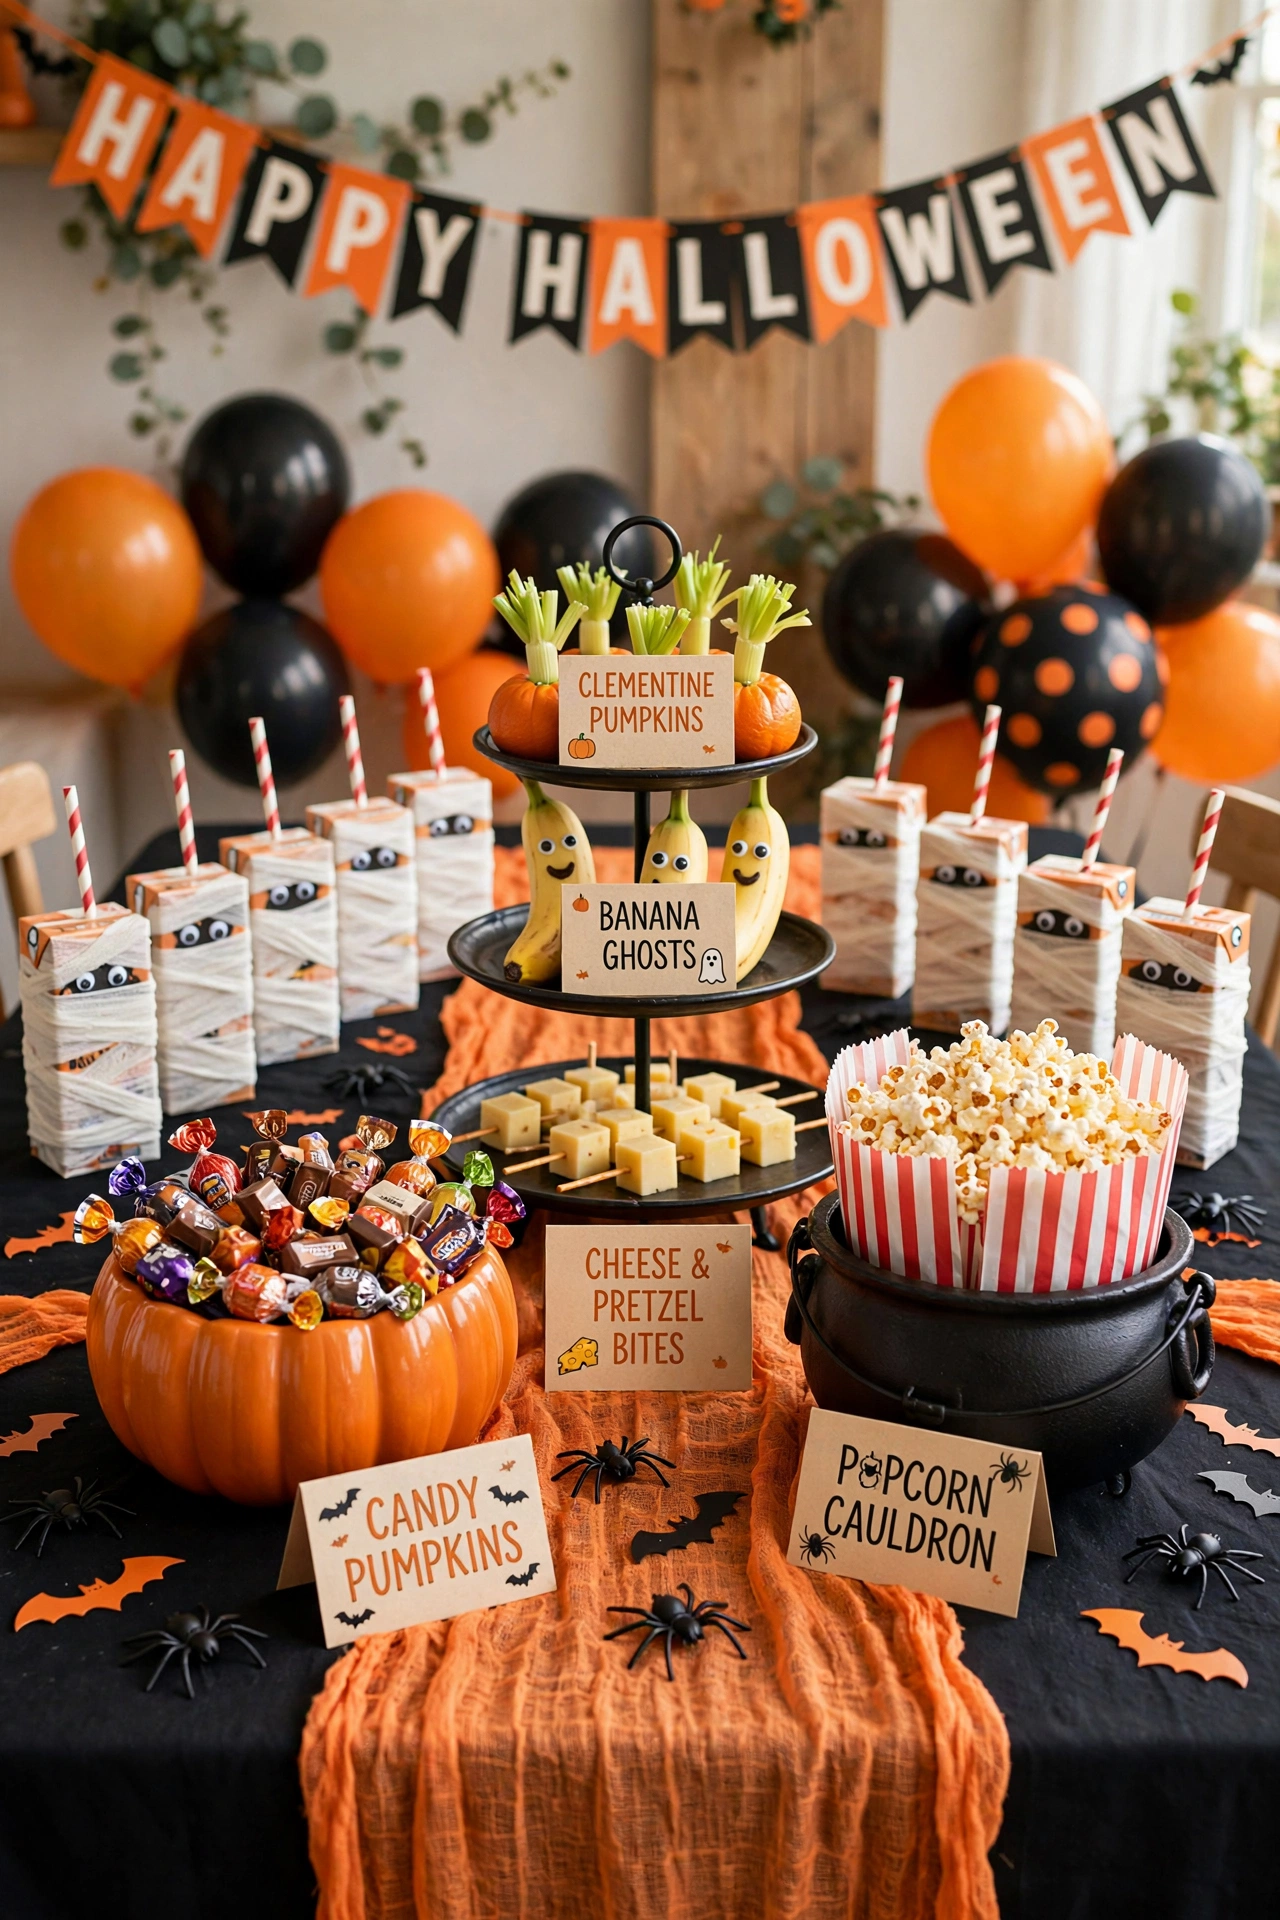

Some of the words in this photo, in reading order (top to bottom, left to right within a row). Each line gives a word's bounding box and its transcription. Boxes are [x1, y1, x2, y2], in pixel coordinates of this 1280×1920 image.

[77, 81, 473, 299] HAPPY
[520, 99, 1197, 326] HALLOWEEN
[578, 671, 715, 698] CLEMENTINE
[590, 705, 704, 733] PUMPKINS
[599, 901, 700, 931] BANANA
[602, 939, 697, 970] GHOSTS
[585, 1247, 682, 1280] CHEESE
[691, 1247, 710, 1280] &
[593, 1289, 704, 1322] PRETZEL
[613, 1332, 685, 1365] BITES
[366, 1475, 478, 1540] CANDY
[823, 1495, 997, 1572] CAULDRON
[344, 1520, 523, 1602] PUMPKINS
